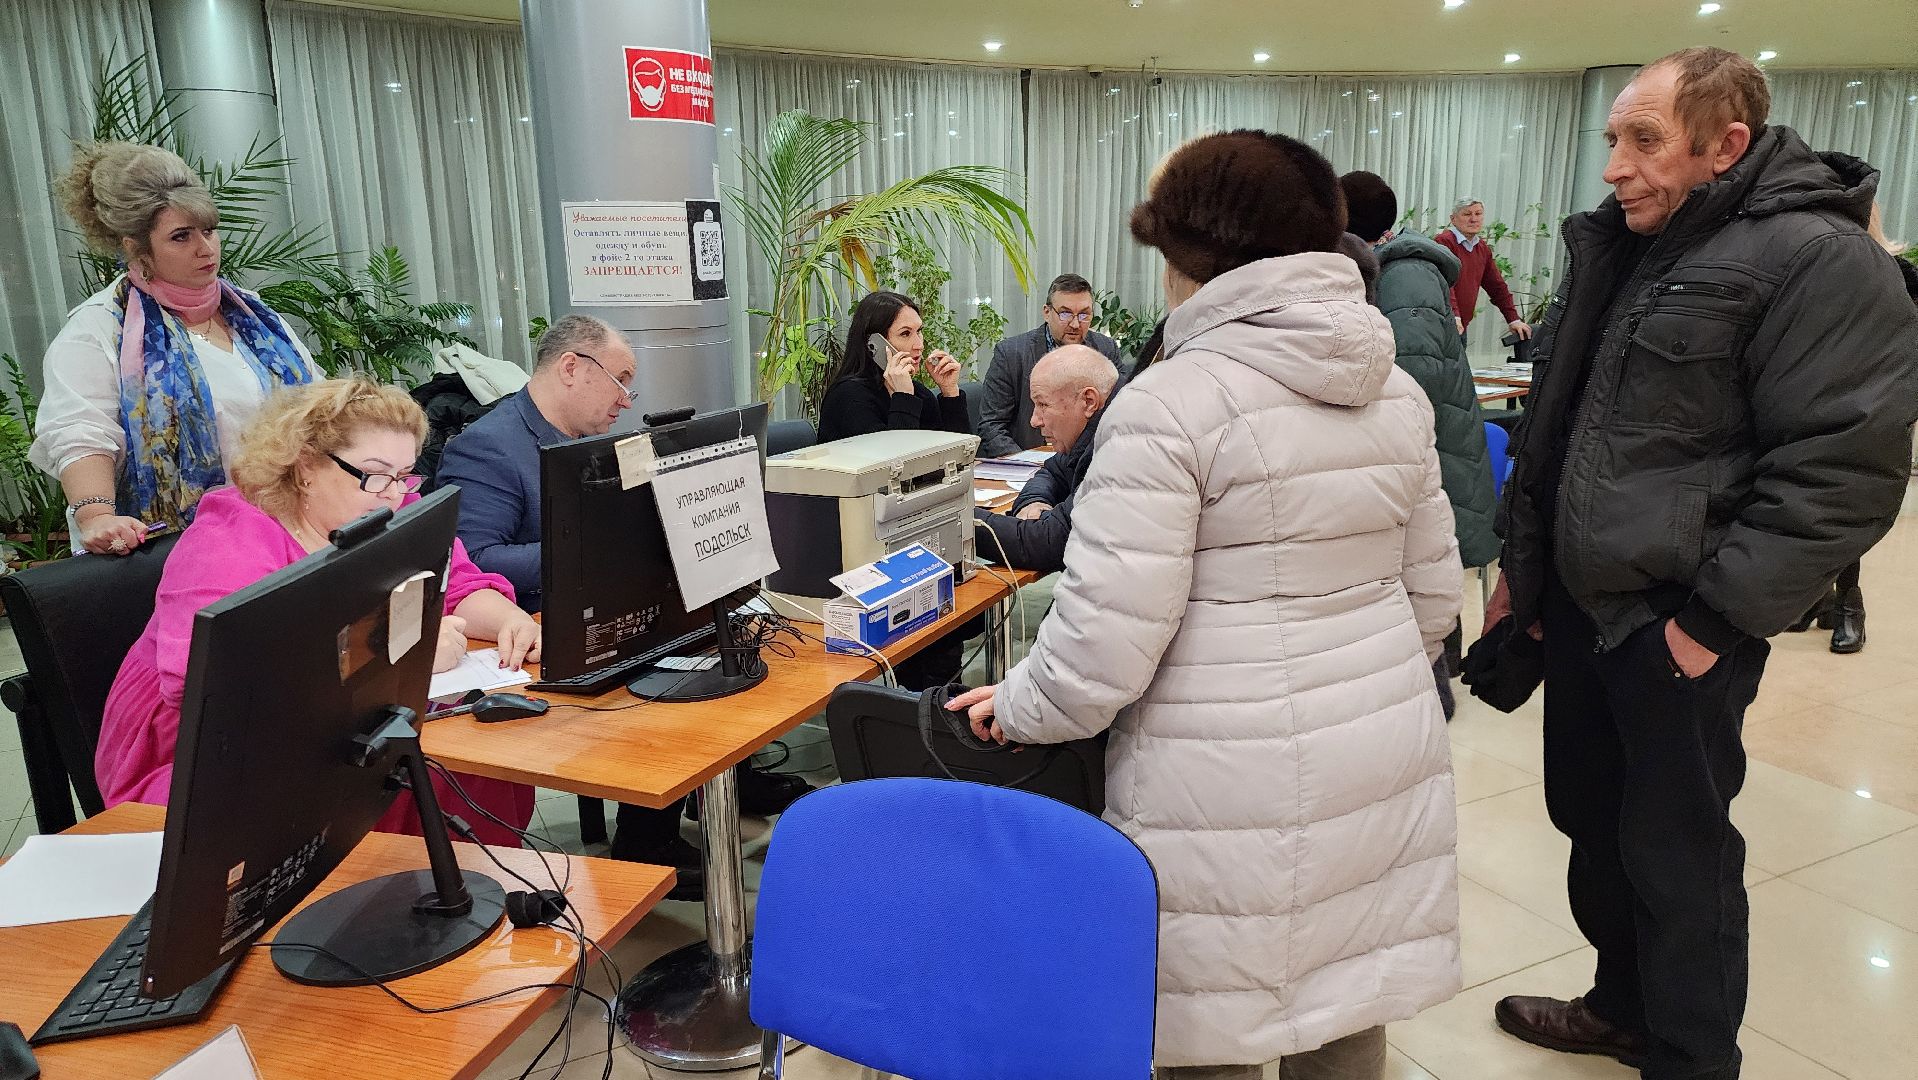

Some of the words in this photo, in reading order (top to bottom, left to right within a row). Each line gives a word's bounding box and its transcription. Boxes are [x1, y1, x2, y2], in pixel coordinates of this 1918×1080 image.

[669, 67, 685, 81] НЕ
[670, 84, 685, 94] БЕЗ
[573, 211, 628, 224] Уважаемые
[573, 228, 622, 237] Оставлять
[595, 242, 628, 251] одежду
[640, 240, 667, 251] обувь
[599, 252, 622, 264] фойе
[583, 265, 684, 277] ЗАПРЕЩАЕТСЯ!
[675, 476, 747, 510] УПРАВЛЯЮЩАЯ
[691, 501, 742, 529] КОМПАНИЯ
[694, 522, 752, 560] ПОДОЛЬСК
